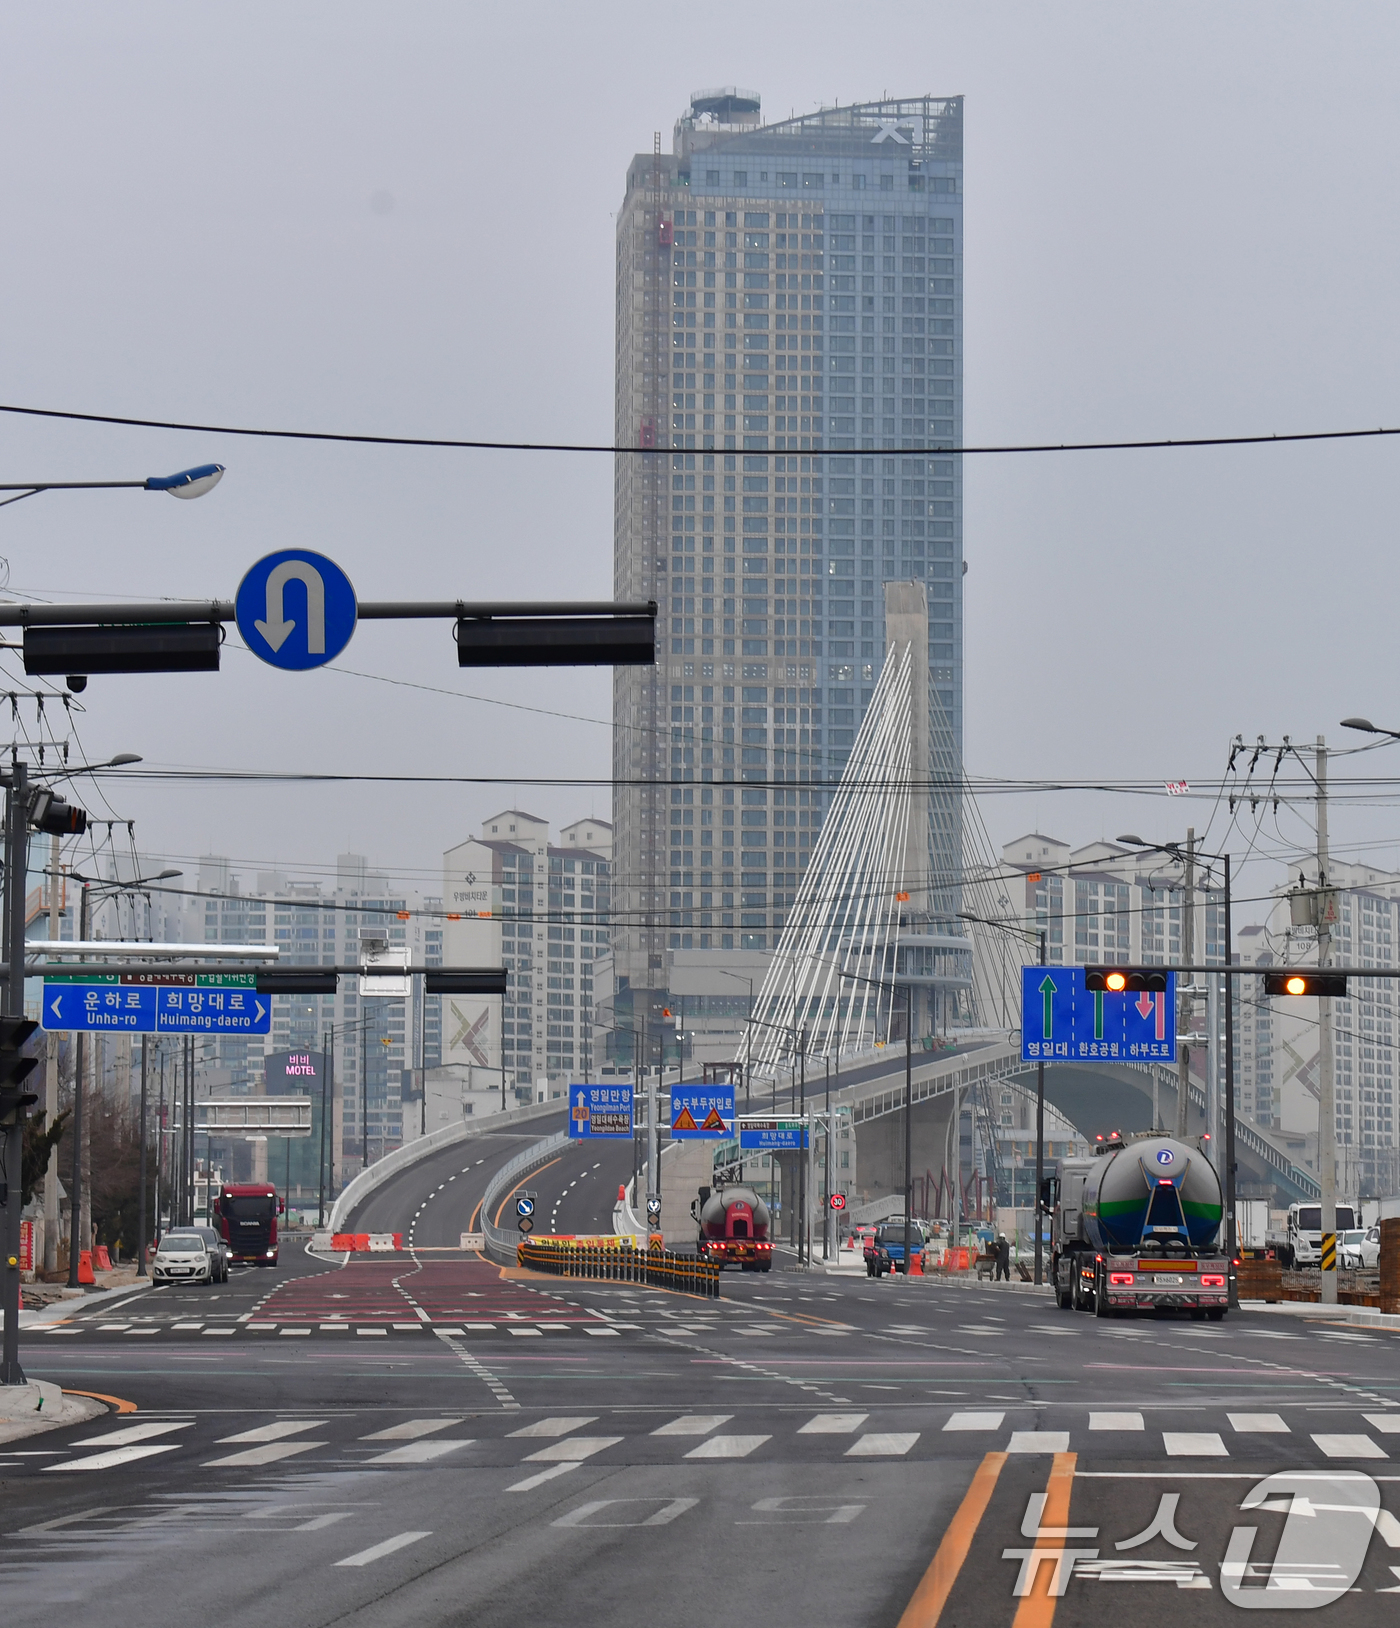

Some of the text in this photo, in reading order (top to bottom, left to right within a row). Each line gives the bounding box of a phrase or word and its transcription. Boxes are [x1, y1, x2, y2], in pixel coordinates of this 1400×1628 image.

[84, 991, 142, 1011] 운하로
[167, 992, 246, 1013] 희망대로
[87, 1012, 137, 1026] Unha-ro
[160, 1013, 251, 1028] Huimang-daero
[1027, 1041, 1068, 1056] 영일대
[1079, 1042, 1119, 1057] 환호공원
[1130, 1042, 1170, 1057] 하부도로
[289, 1054, 309, 1065] 비비
[285, 1065, 316, 1075] MOTEL
[590, 1089, 631, 1103] 영일만항
[590, 1103, 630, 1113] Yeongilman Port
[673, 1097, 733, 1110] 송도부두진입로
[575, 1109, 587, 1119] 20
[762, 1132, 793, 1141] 희망대로
[834, 1198, 842, 1206] 30
